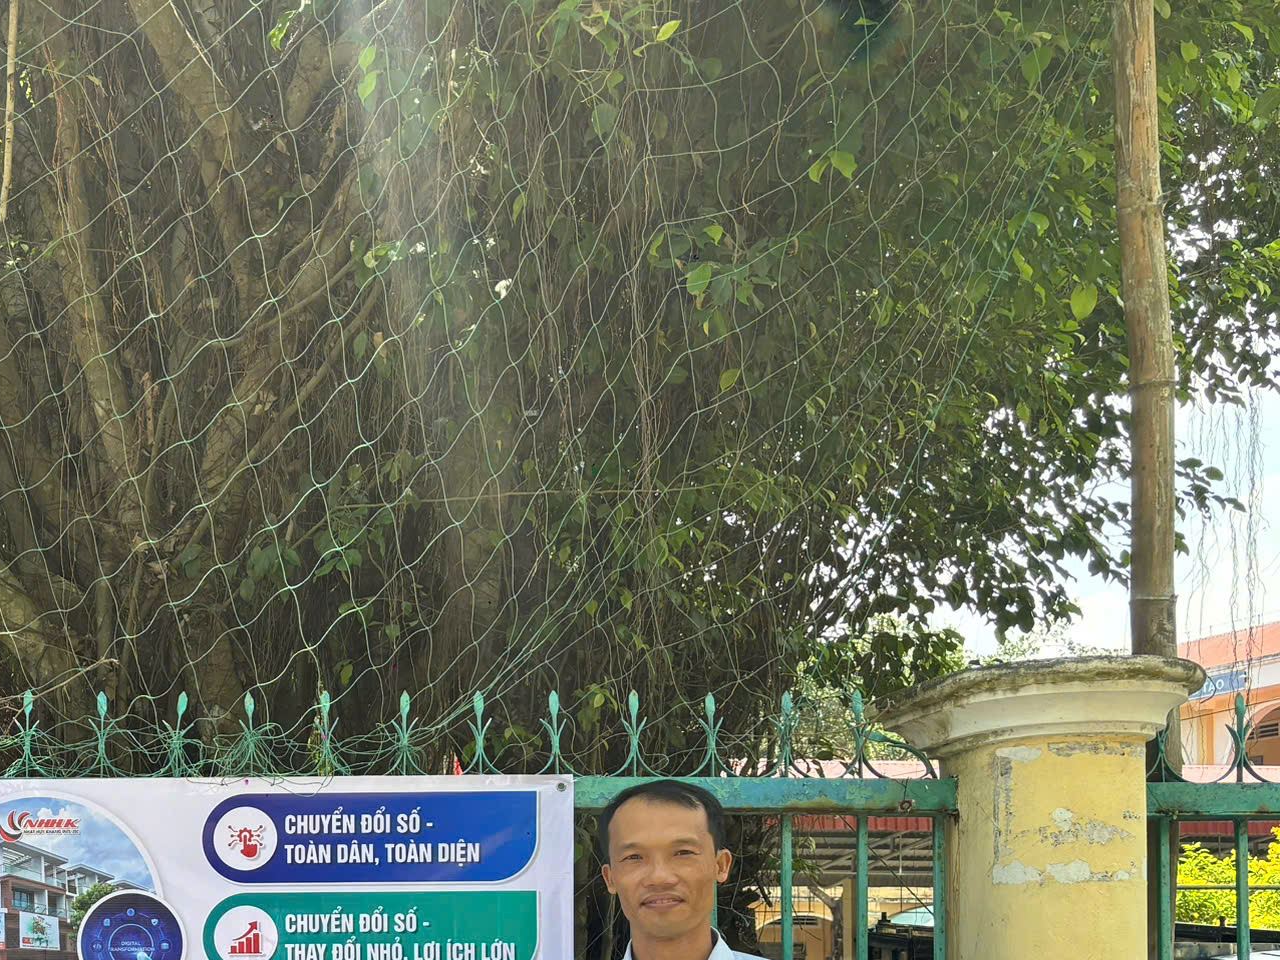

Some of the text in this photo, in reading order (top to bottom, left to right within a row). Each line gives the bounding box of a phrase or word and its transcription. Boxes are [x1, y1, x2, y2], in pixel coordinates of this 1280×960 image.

[24, 819, 80, 828] NHHK
[285, 807, 355, 834] CHUYỂN
[360, 807, 391, 834] ĐỔI
[397, 807, 422, 833] SỐ
[285, 840, 480, 868] TOÀN DÂN, TOÀN DIỆN
[285, 907, 354, 933] CHUYỂN
[360, 907, 388, 933] ĐỔI
[394, 907, 418, 932] SỐ
